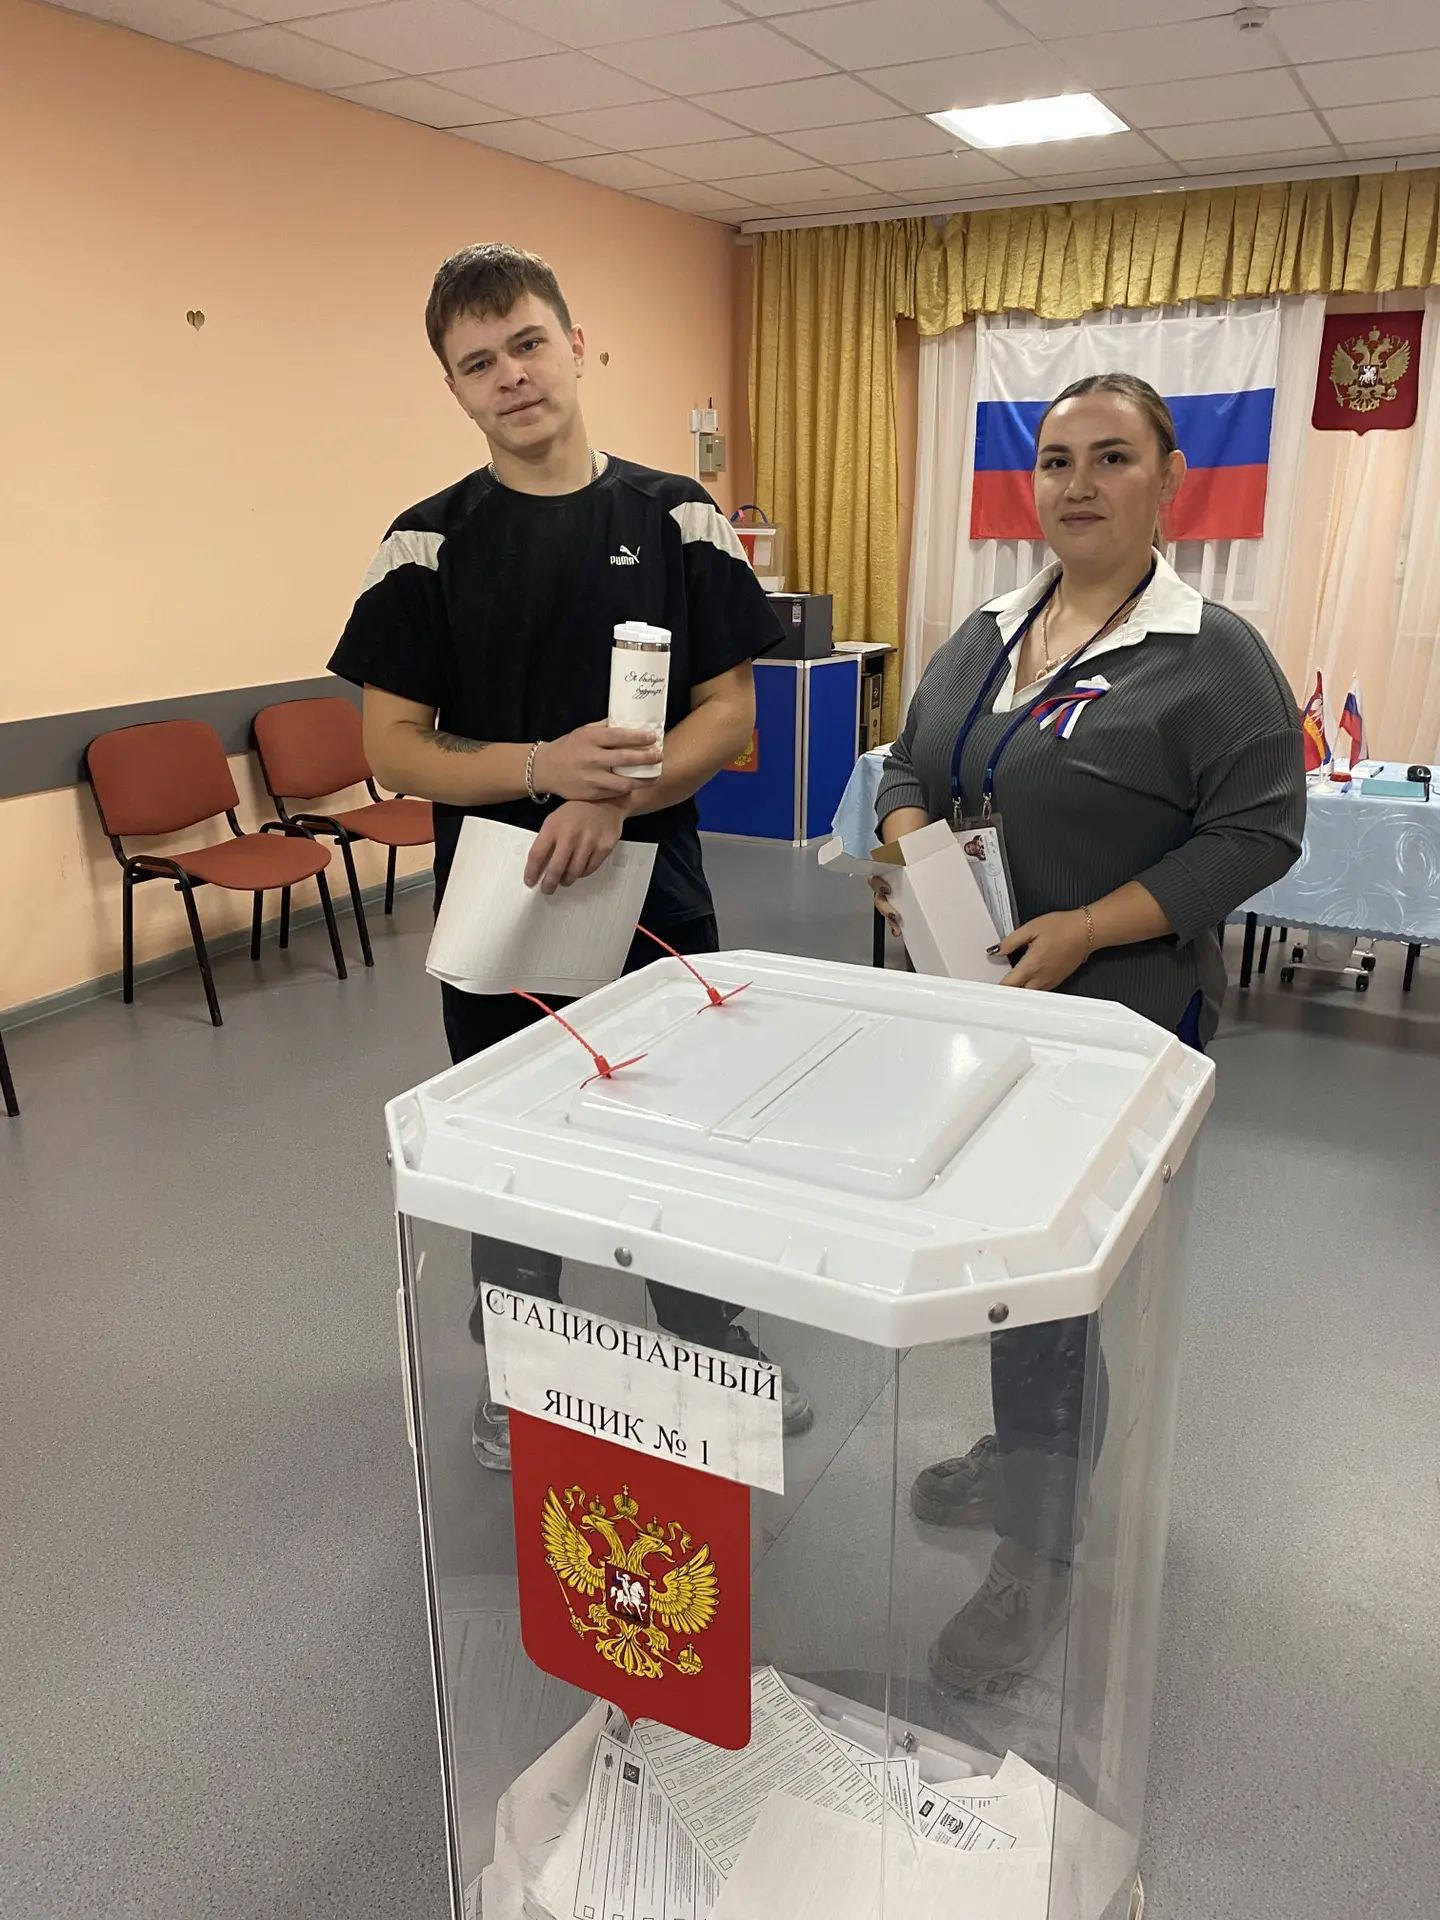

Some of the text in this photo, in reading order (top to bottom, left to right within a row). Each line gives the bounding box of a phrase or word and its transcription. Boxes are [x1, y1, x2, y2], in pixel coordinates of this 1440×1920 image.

[610, 555, 635, 566] PUMA
[486, 1288, 779, 1401] СТАЦИОНАРНЫЙ
[541, 1389, 710, 1465] ЯЩИК № 1
